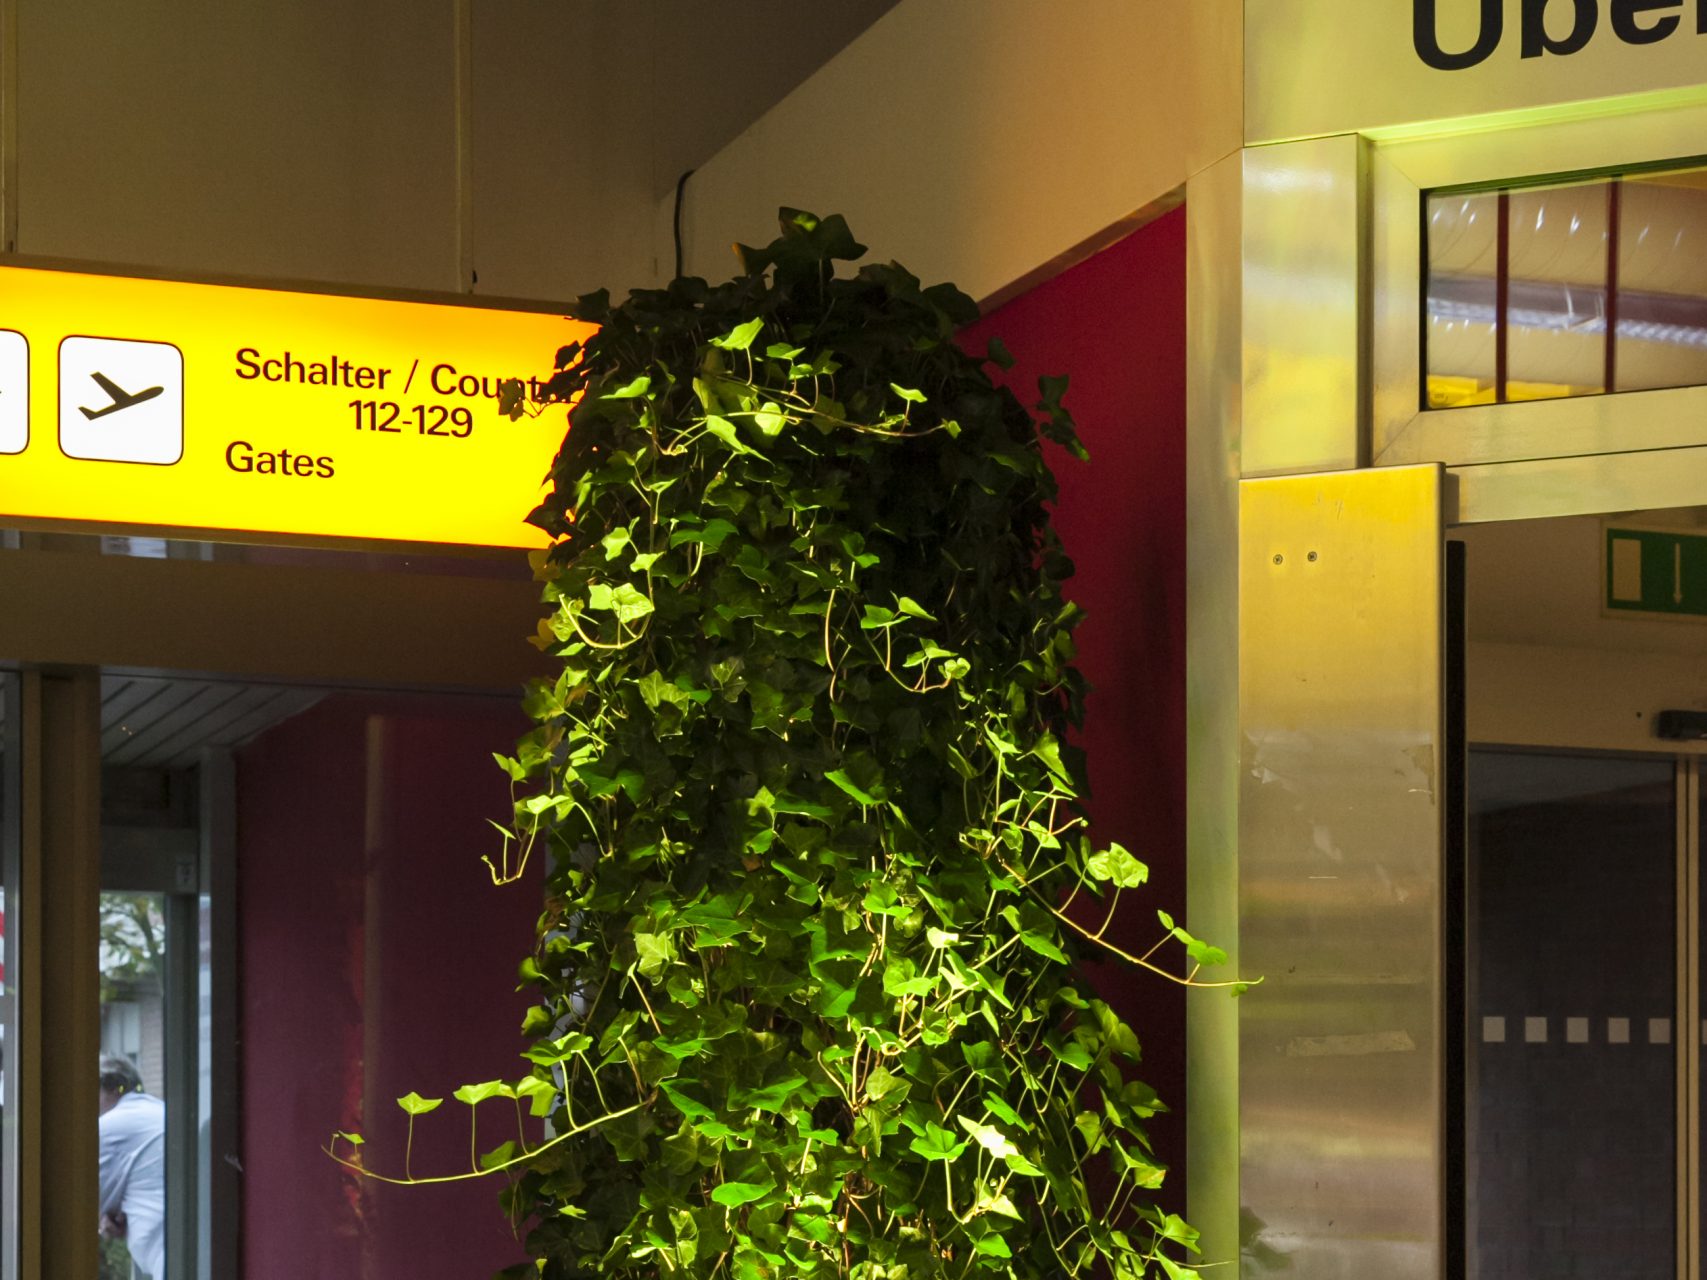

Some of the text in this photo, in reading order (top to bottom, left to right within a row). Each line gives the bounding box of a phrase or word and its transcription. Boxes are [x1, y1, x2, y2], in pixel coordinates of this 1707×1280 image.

[235, 347, 570, 403] Schalter / Count
[349, 400, 473, 438] 112-129
[225, 440, 335, 479] Gates
